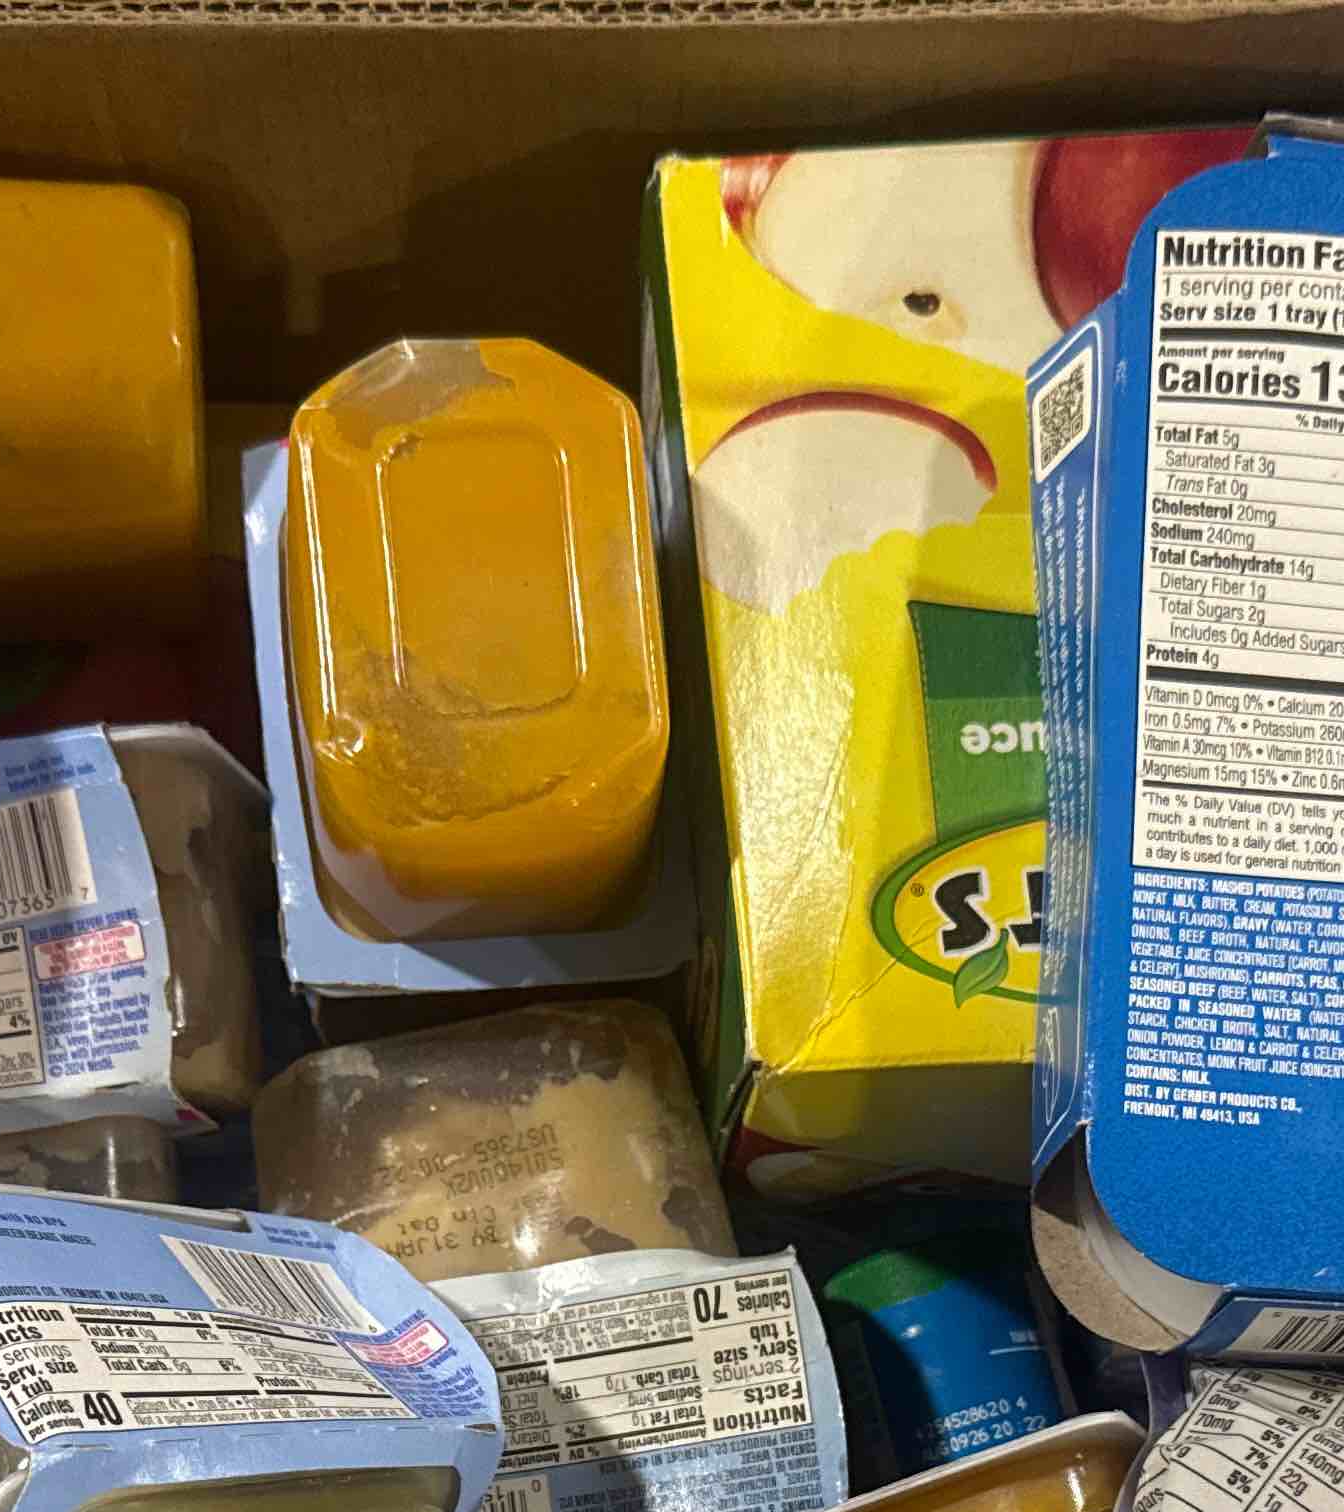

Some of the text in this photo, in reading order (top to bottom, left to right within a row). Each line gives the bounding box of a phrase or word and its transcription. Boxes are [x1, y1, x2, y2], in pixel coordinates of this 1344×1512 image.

[1163, 236, 1305, 269] Nutrition
[1163, 277, 1171, 295] 1
[1180, 279, 1254, 300] serving
[1260, 281, 1292, 301] per
[1160, 302, 1206, 322] Serv
[1214, 302, 1256, 321] size
[1268, 305, 1277, 321] 1
[1285, 305, 1326, 329] tray
[1158, 362, 1301, 399] Calories
[693, 1285, 791, 1324] Calories 70
[750, 1321, 795, 1343] 1 tub
[713, 1339, 798, 1366] Serv. size
[47, 1359, 79, 1375] size
[6, 1377, 54, 1407] 1 tub
[744, 1380, 803, 1405] Facts
[18, 1392, 123, 1427] Calories 40
[713, 1403, 807, 1432] Nutrition
